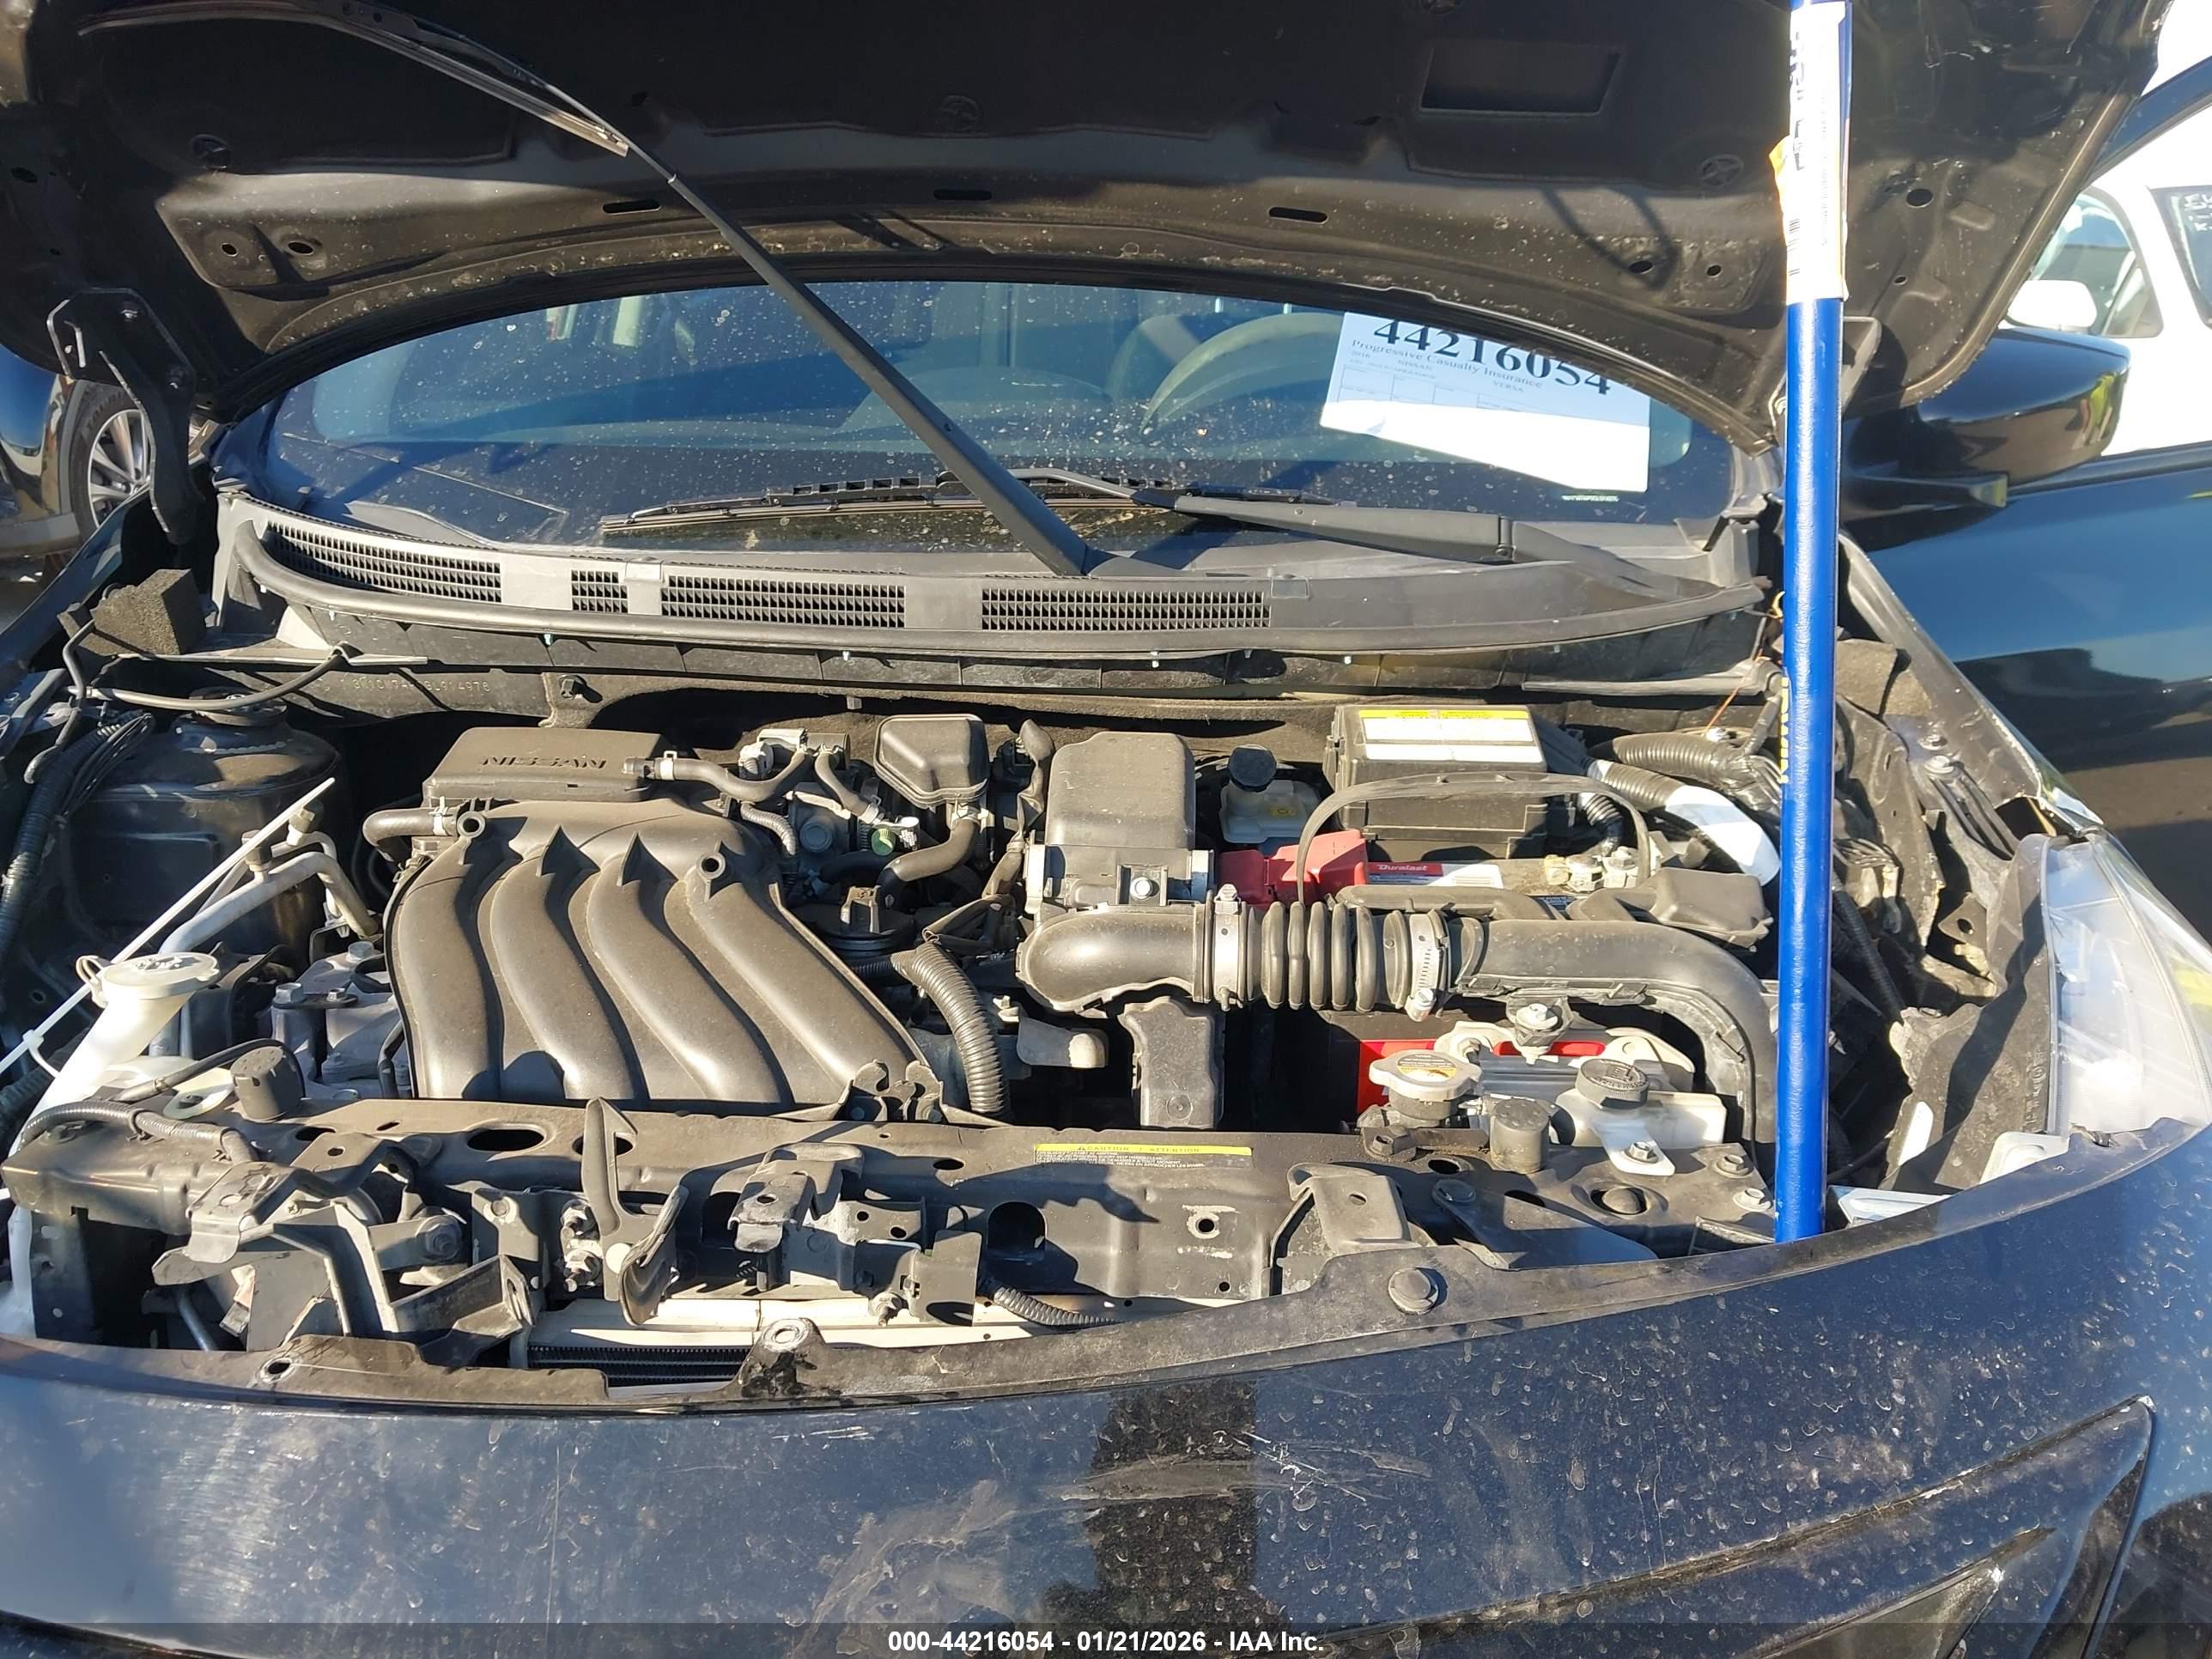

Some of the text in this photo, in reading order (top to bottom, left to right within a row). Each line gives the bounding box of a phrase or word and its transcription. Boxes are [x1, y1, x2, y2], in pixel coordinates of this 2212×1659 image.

[1352, 339, 1423, 360] Progressive
[1427, 354, 1481, 374] Casualty
[1484, 368, 1543, 388] Insurance
[1373, 320, 1611, 395] 44216054
[480, 756, 608, 769] NISSAN
